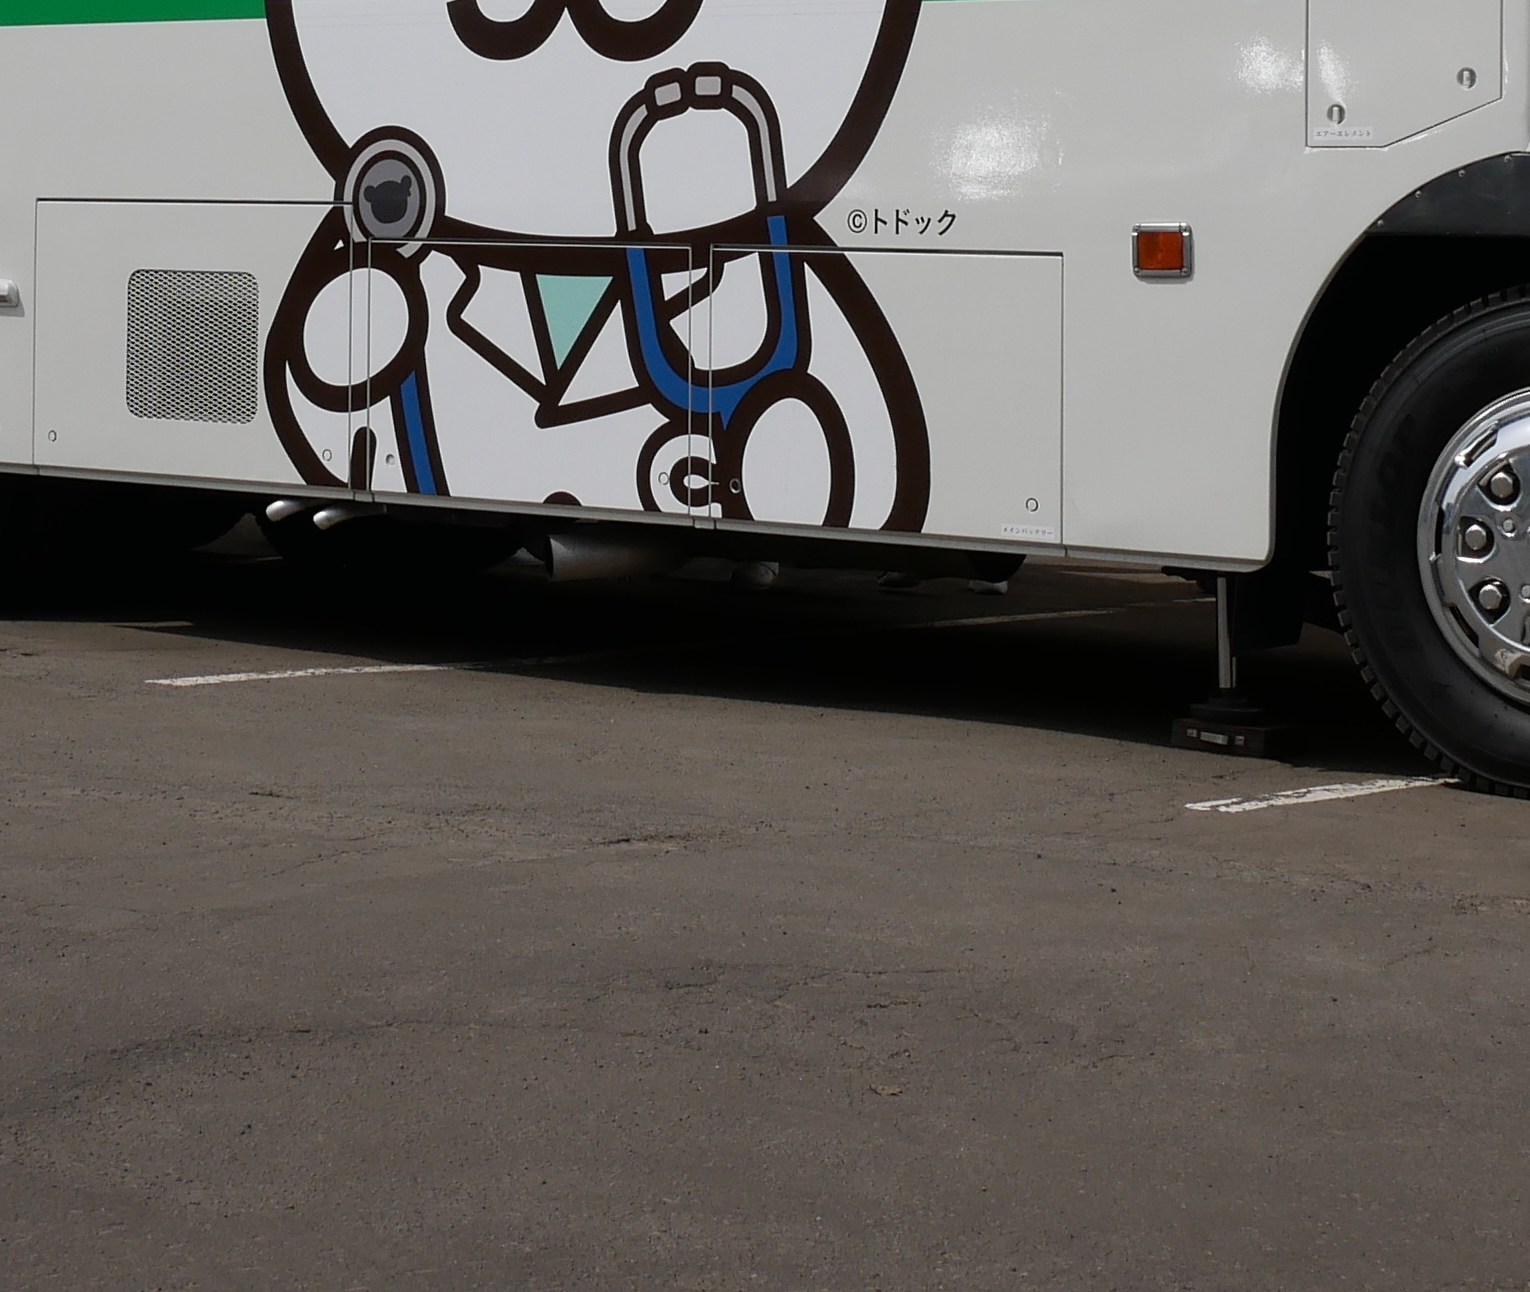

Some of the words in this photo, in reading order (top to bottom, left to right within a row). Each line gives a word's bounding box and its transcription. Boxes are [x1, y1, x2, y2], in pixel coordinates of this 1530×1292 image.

[1315, 129, 1371, 138] エアーエレメント
